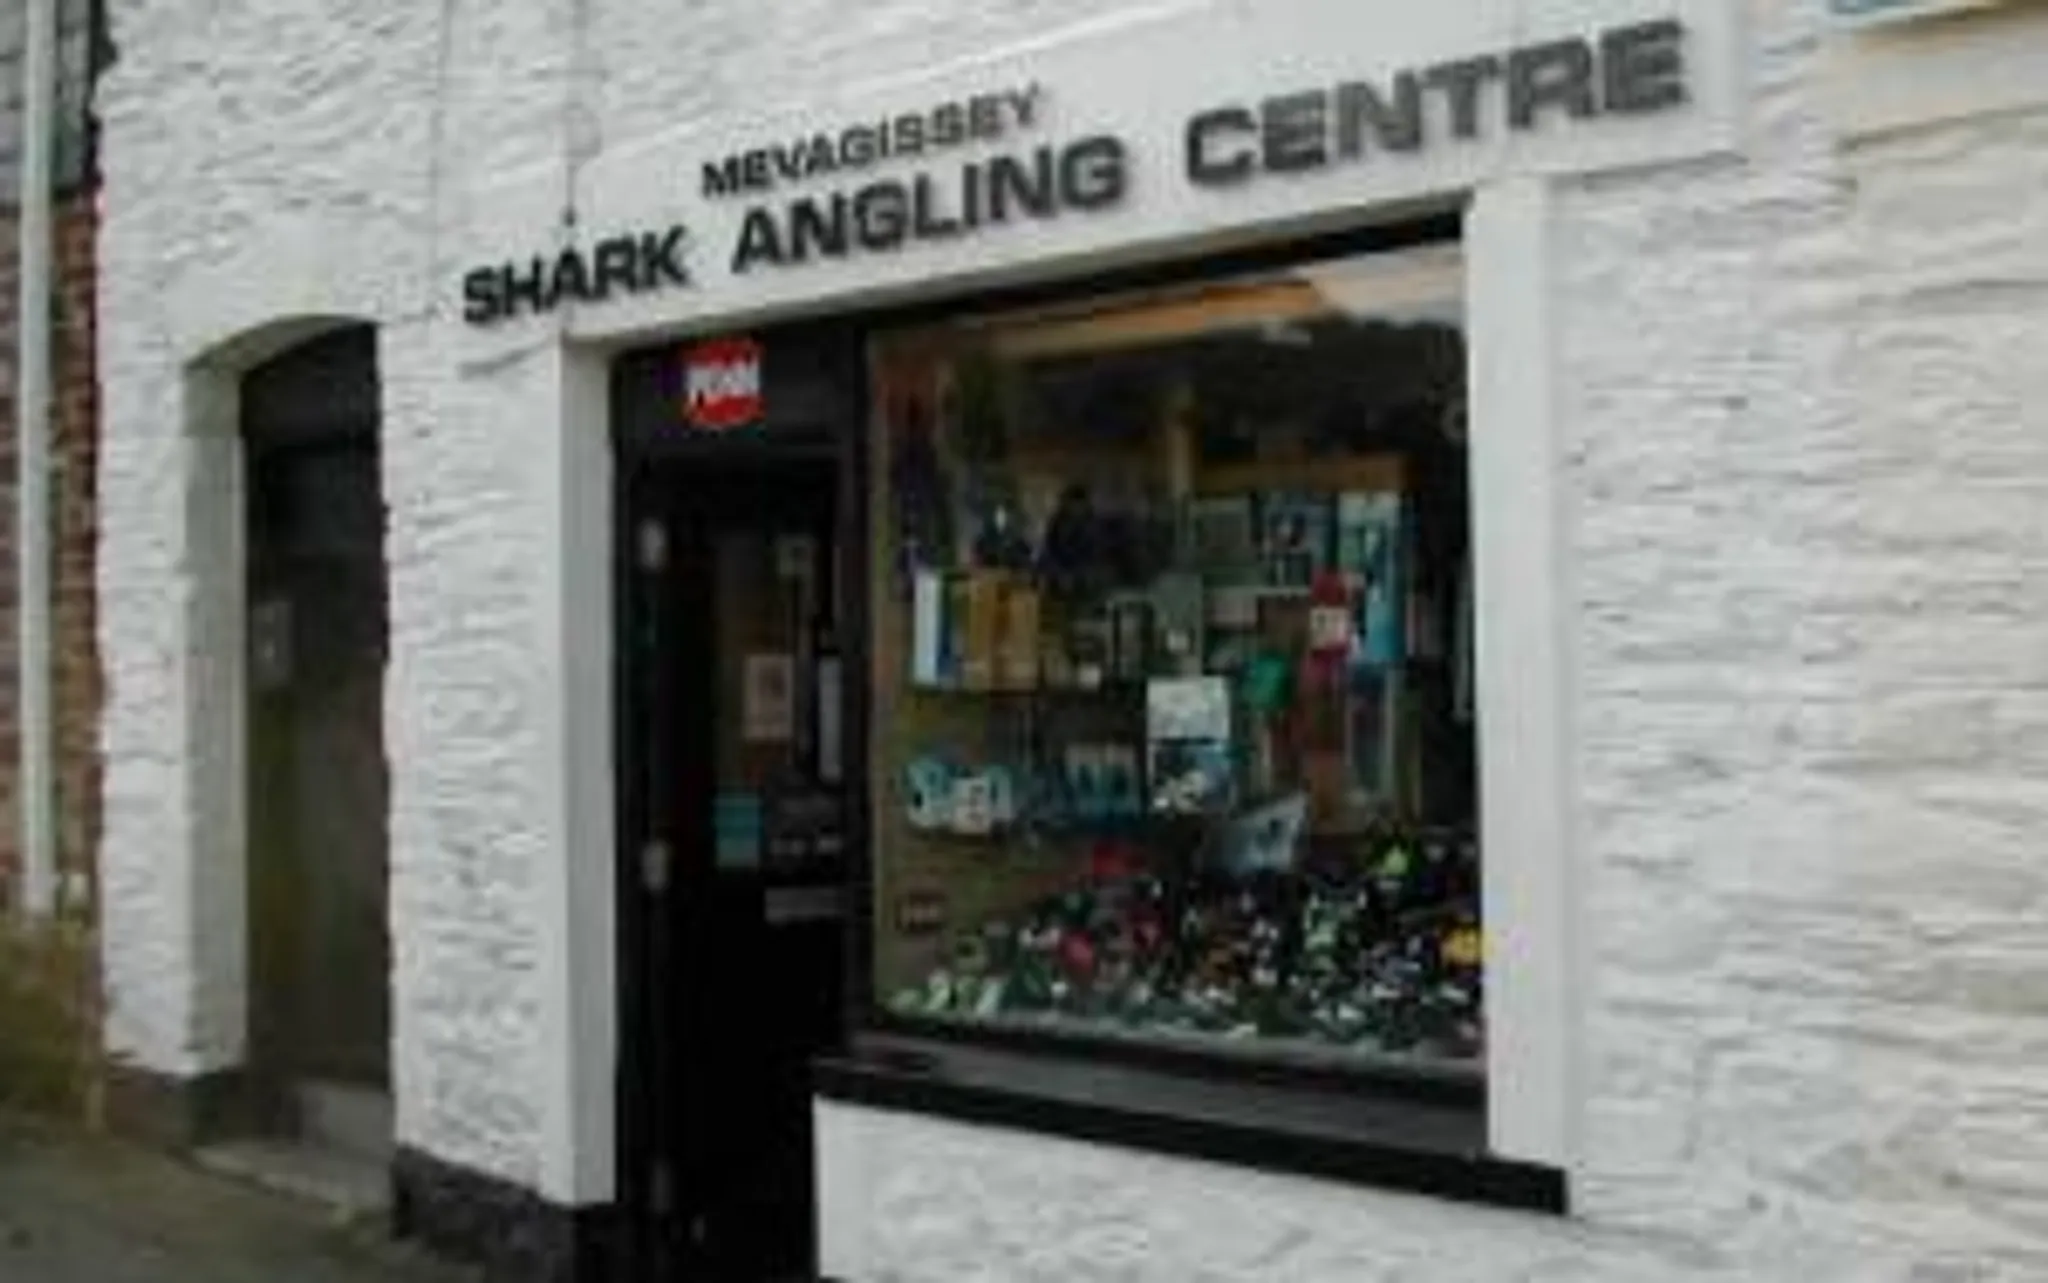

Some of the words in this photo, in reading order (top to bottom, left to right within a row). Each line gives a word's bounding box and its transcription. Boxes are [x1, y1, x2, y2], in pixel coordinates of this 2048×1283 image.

[463, 225, 689, 325] SHARK
[731, 134, 1128, 274] ANGLING
[1186, 19, 1690, 187] CENTRE
[702, 83, 1044, 198] MEVAGISSEY
